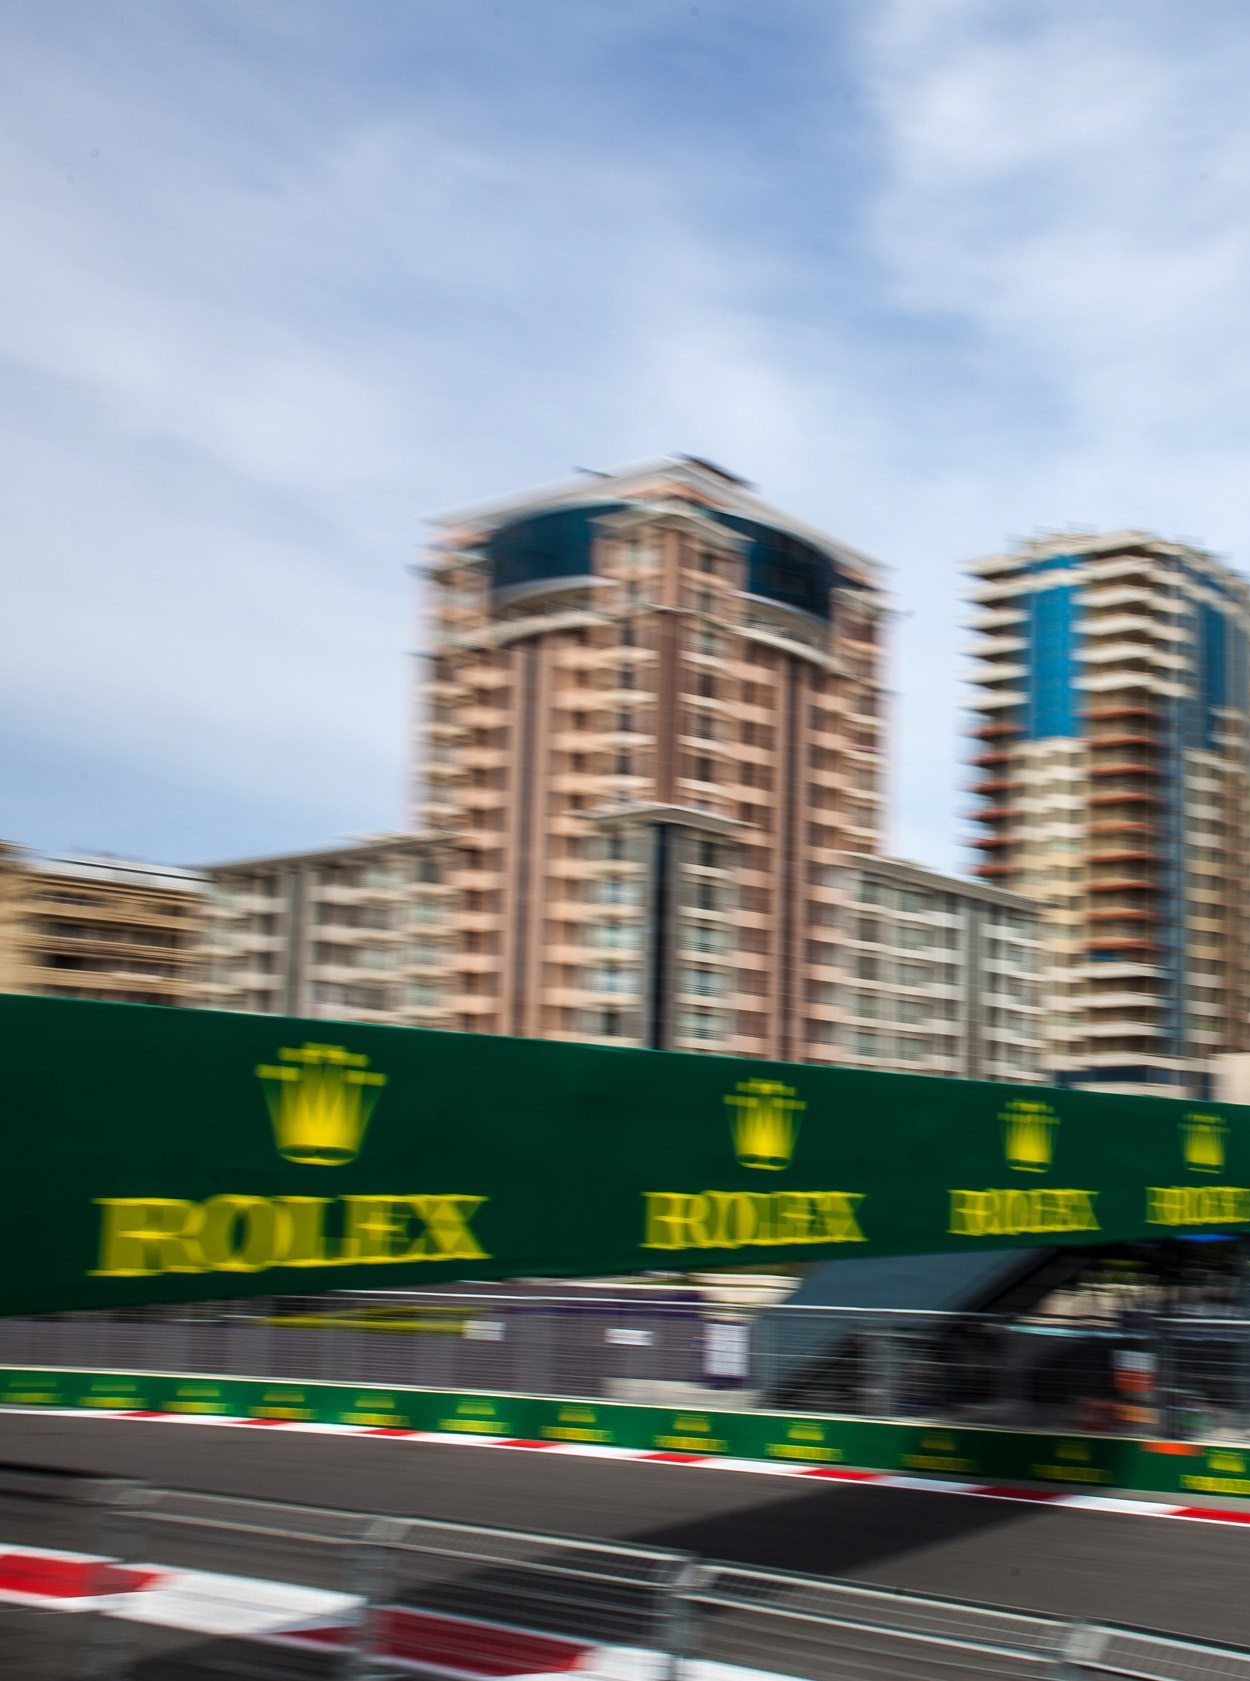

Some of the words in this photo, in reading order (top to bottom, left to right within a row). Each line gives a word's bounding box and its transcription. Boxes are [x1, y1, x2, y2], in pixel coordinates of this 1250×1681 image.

[90, 1194, 489, 1276] ROLEX
[642, 1191, 865, 1249] ROLEX
[948, 1188, 1098, 1235] ROLEX
